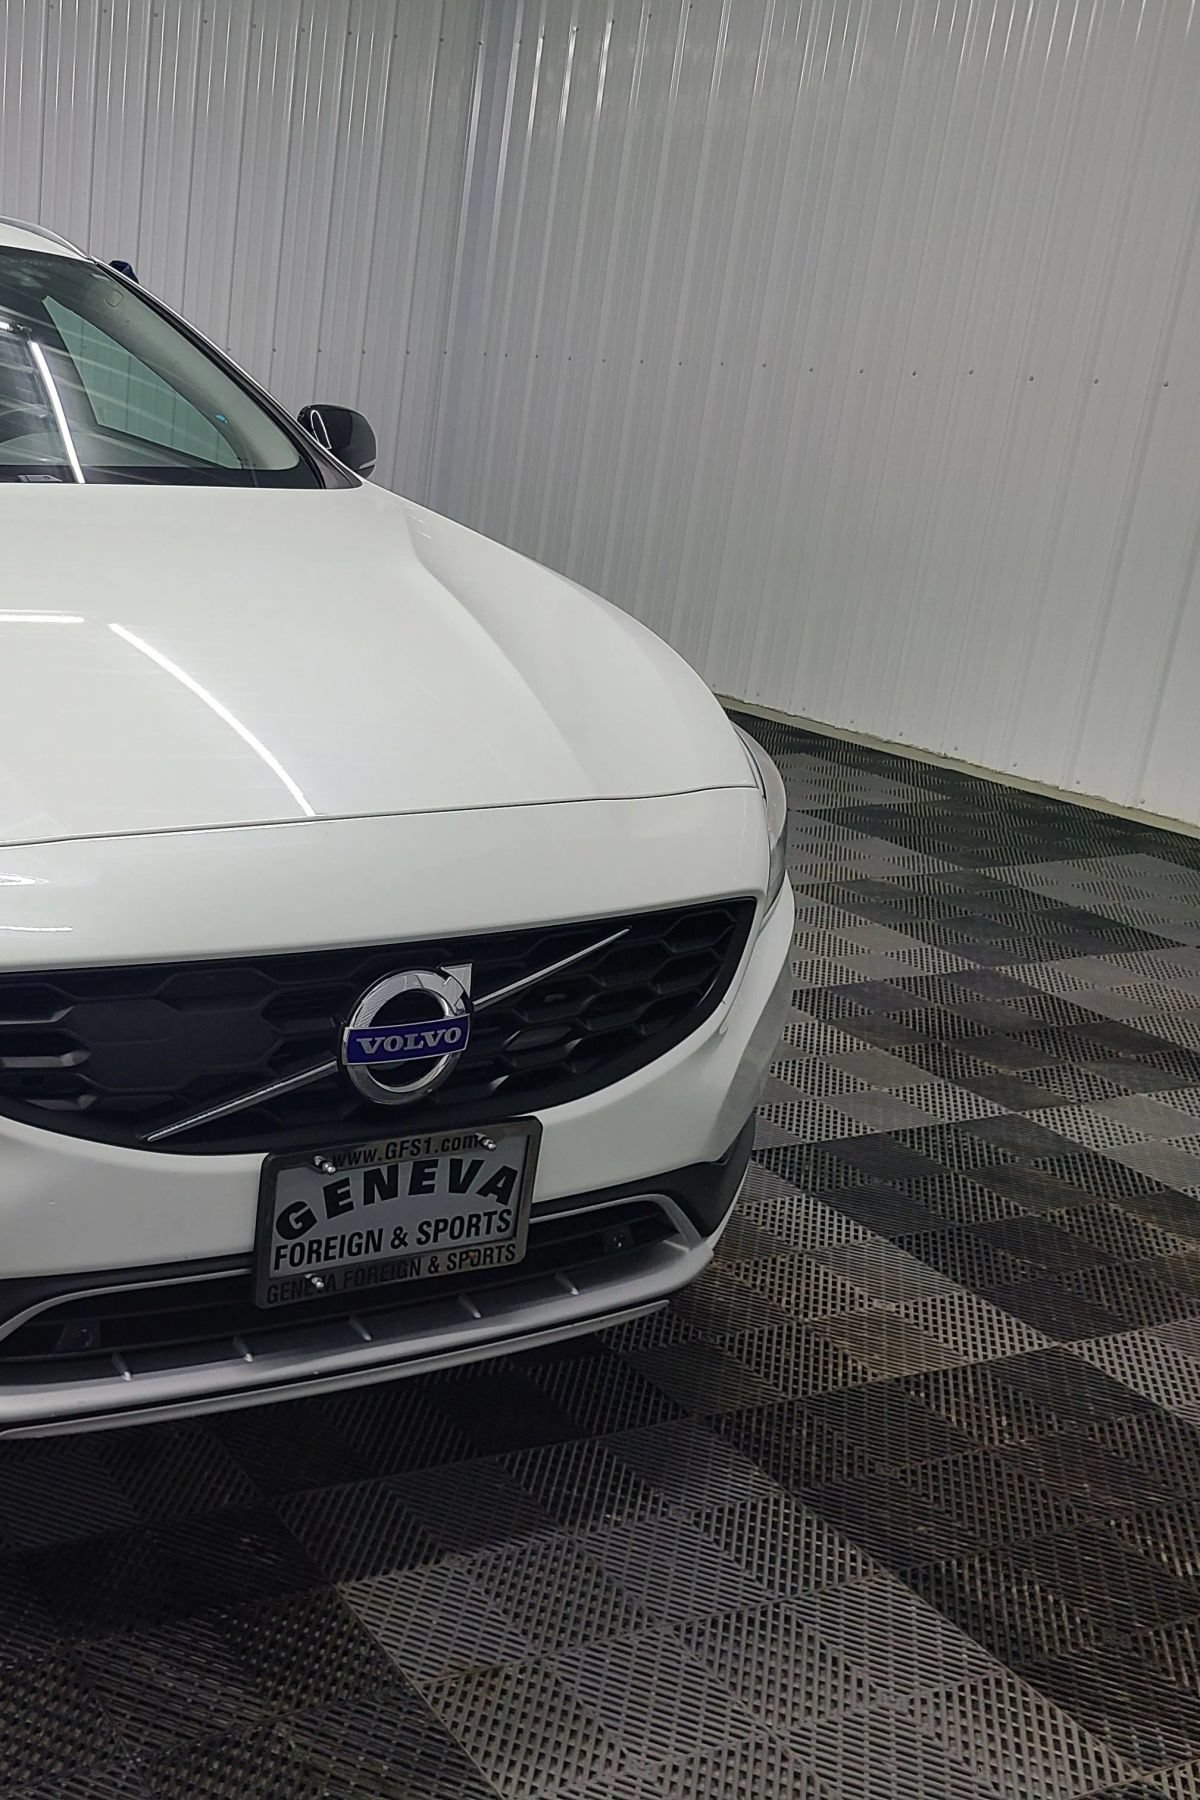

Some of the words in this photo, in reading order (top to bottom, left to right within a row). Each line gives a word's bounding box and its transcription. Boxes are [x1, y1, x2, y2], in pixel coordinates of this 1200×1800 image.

[356, 1027, 462, 1054] VOLVO
[333, 1135, 478, 1167] www.GFS1.com
[275, 1158, 518, 1241] GENEVA
[274, 1228, 384, 1271] FOREIGN
[390, 1226, 409, 1250] &
[416, 1208, 513, 1246] SPORTS
[344, 1258, 422, 1288] FOREIGN
[427, 1256, 440, 1275] &
[446, 1243, 517, 1271] SPORTS
